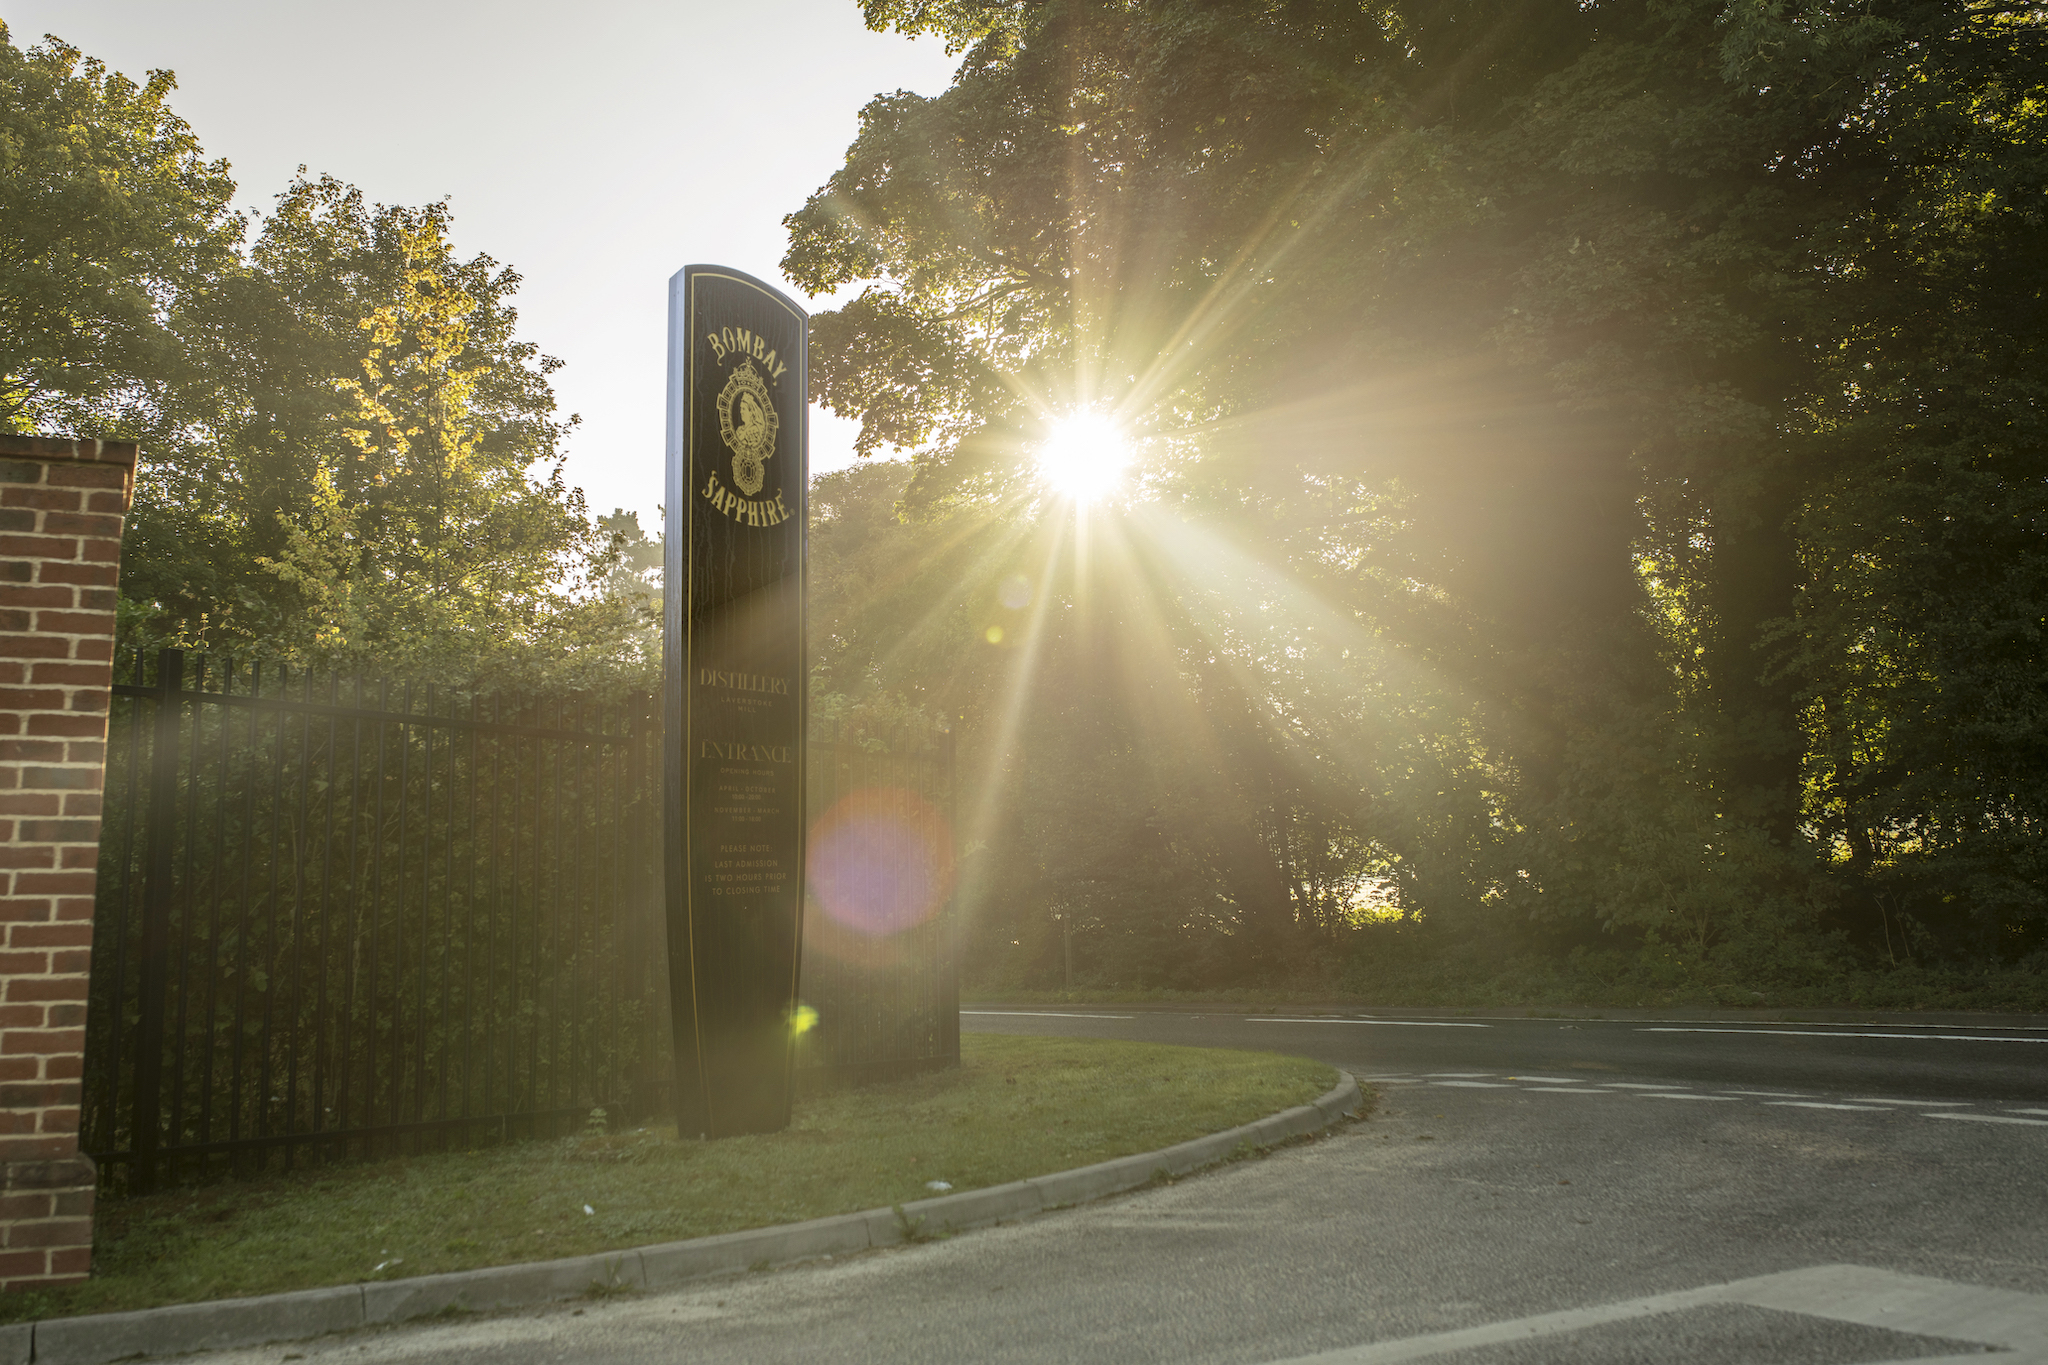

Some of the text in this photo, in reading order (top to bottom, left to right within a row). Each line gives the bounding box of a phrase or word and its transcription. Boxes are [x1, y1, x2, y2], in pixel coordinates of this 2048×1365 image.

[701, 470, 790, 527] SAPPHIRE
[700, 668, 791, 695] DISTILLERY
[720, 697, 772, 706] LAVERSTOKE
[702, 740, 791, 763] ENTRANCE
[736, 860, 778, 868] ADMISSION
[736, 873, 762, 881] HOURS
[726, 886, 760, 895] CLOSING
